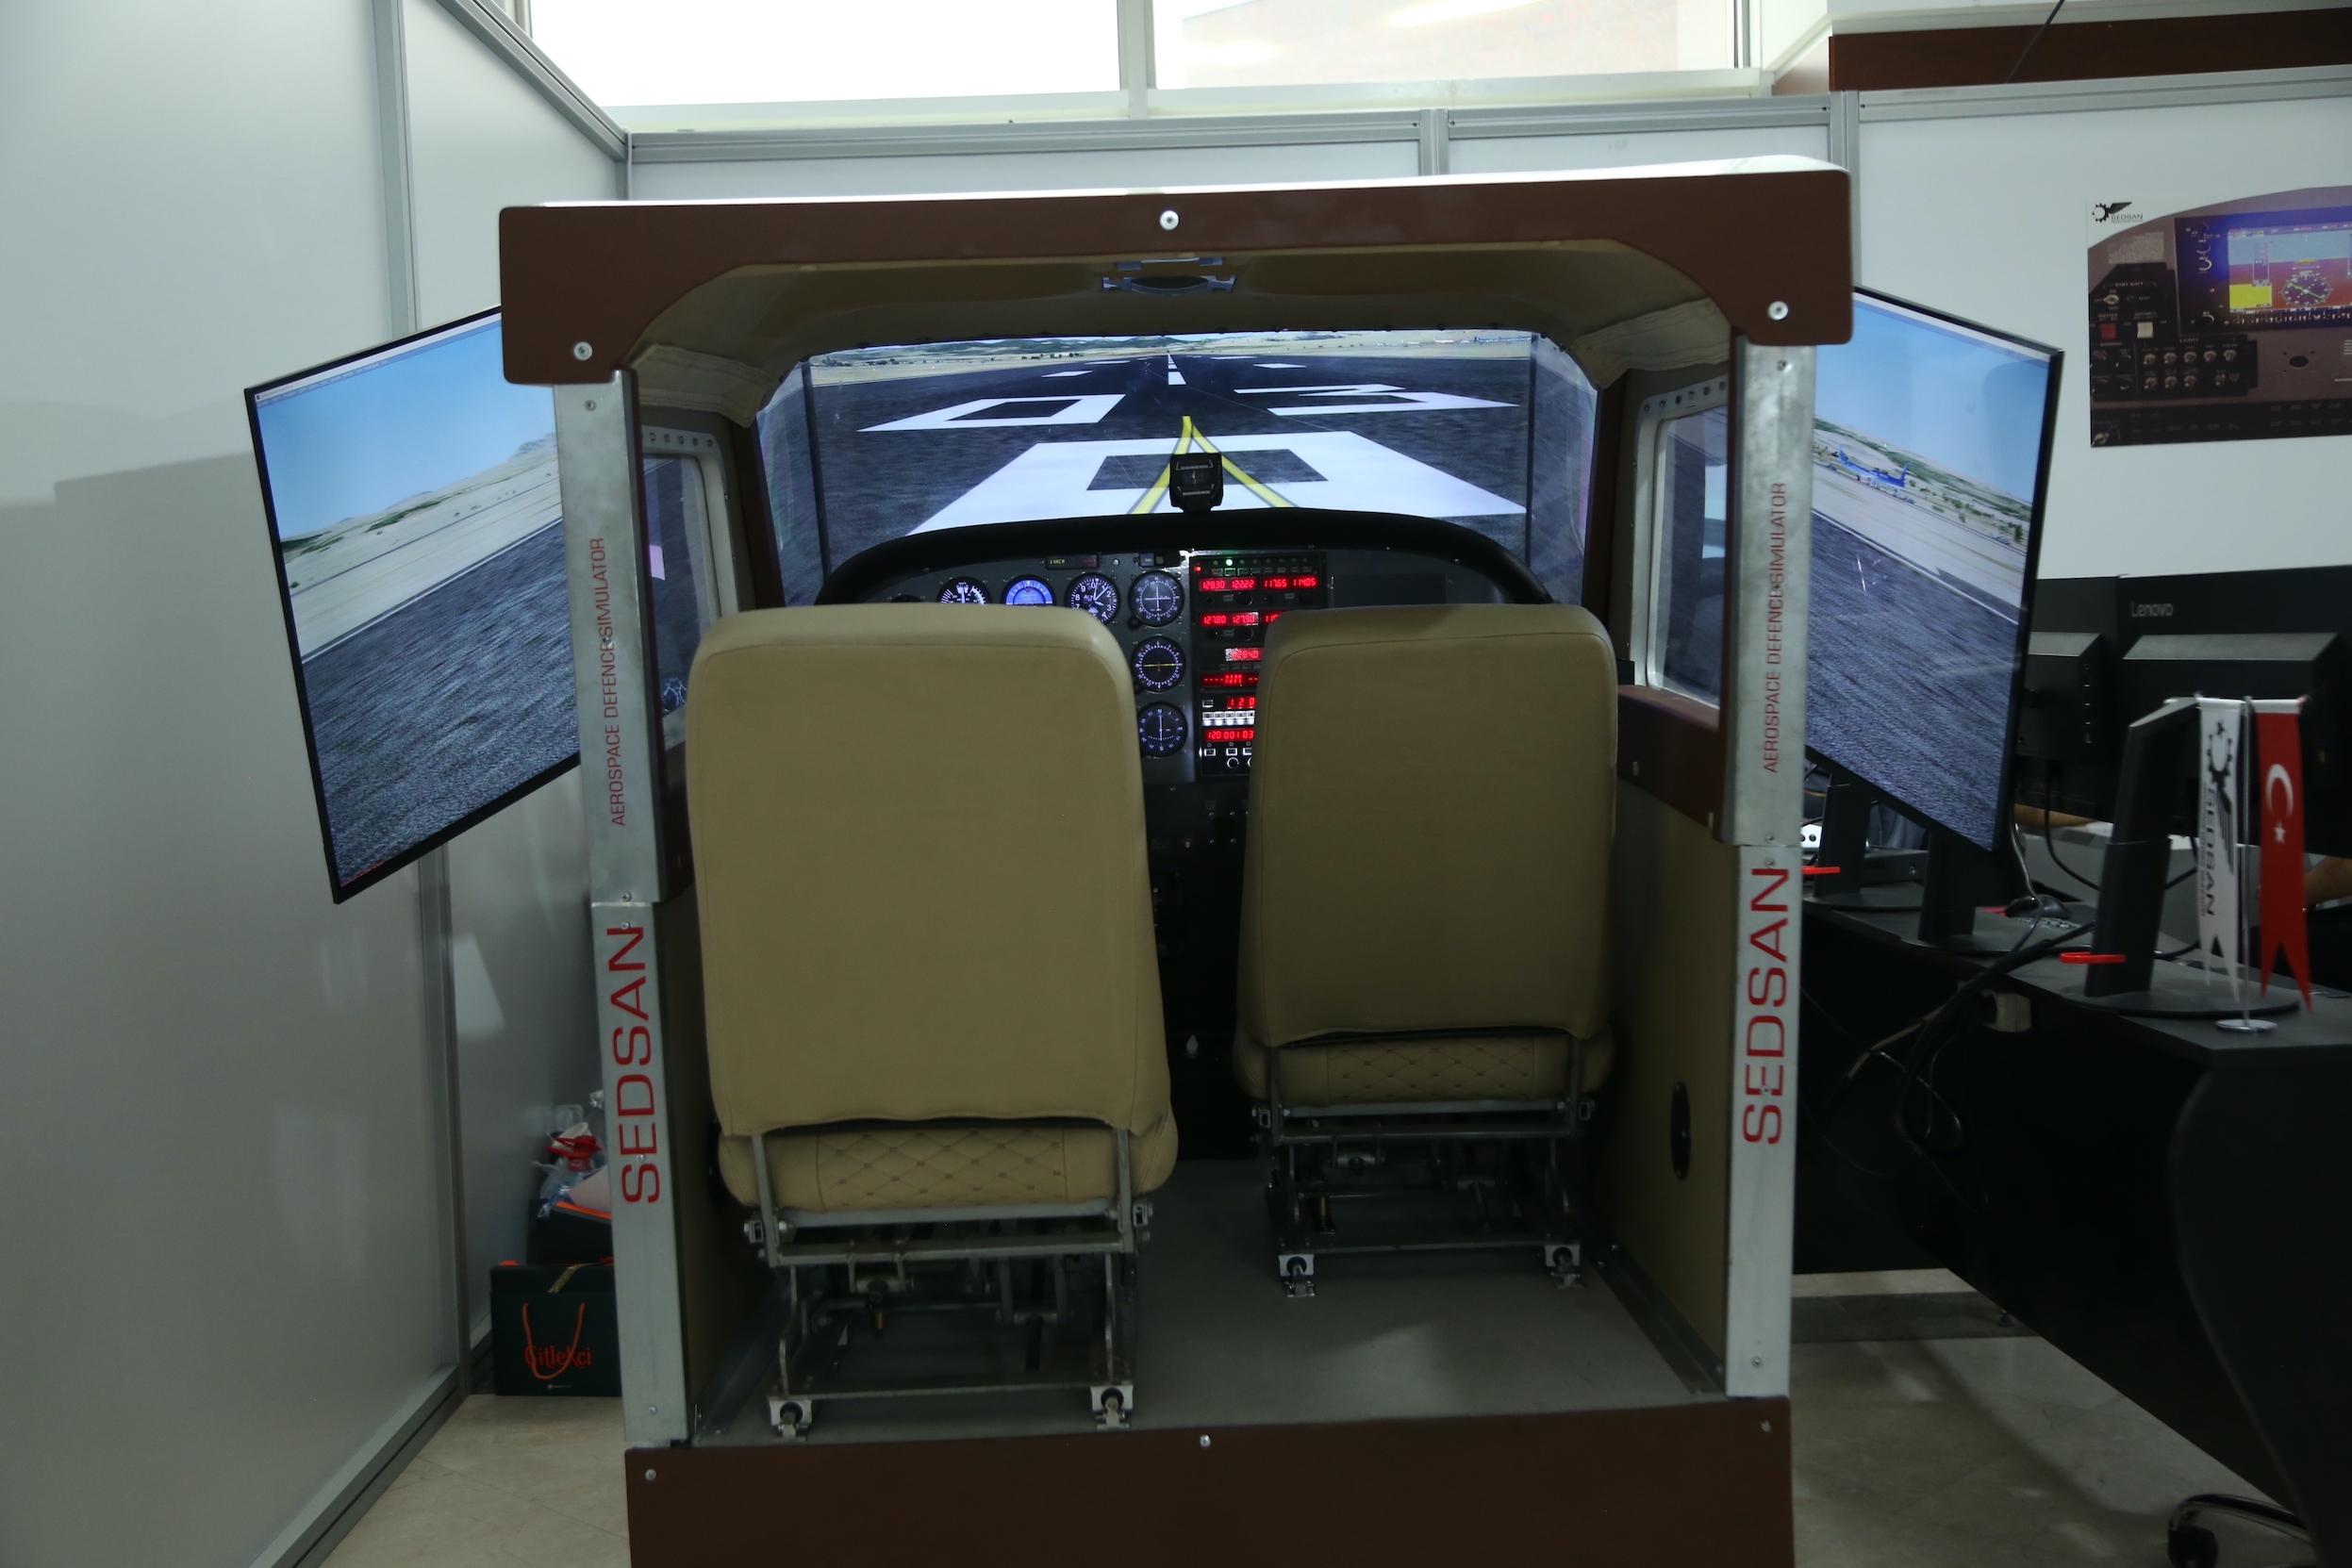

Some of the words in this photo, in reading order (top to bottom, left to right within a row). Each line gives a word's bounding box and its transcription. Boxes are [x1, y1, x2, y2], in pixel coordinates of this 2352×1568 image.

[1769, 482, 1787, 584] SIMULATOR
[589, 536, 613, 638] SIMULATOR
[1765, 588, 1783, 665] DEFENCE
[2129, 601, 2174, 618] Lenovo
[600, 643, 619, 718] DEFENCE
[1763, 670, 1781, 773] AEROSPACE
[604, 724, 625, 826] AEROSPACE
[1742, 868, 1789, 1145] SEDSAN
[606, 927, 660, 1203] SEDSAN
